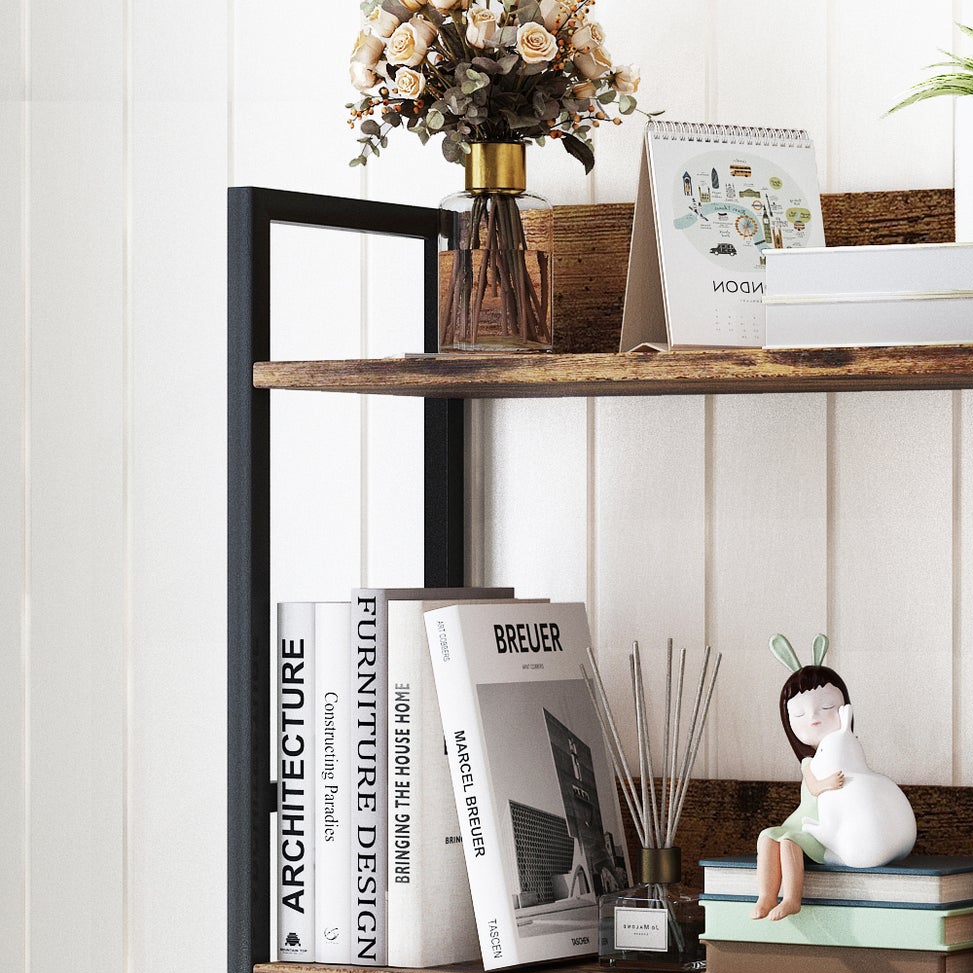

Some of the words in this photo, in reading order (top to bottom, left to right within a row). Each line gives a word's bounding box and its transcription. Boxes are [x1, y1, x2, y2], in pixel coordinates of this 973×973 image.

[493, 623, 563, 653] BREUER
[321, 692, 338, 781] Constructing
[357, 595, 377, 812] FURNITURE
[395, 683, 411, 723] HOME
[281, 639, 305, 914] ARCHITECTURE
[395, 729, 411, 776] HOUSE
[325, 785, 339, 842] Paradies
[395, 781, 411, 808] THE
[454, 730, 474, 792] MARCEL
[465, 796, 486, 858] BREUER
[395, 813, 411, 884] BRINGING
[357, 824, 377, 961] DESIGN
